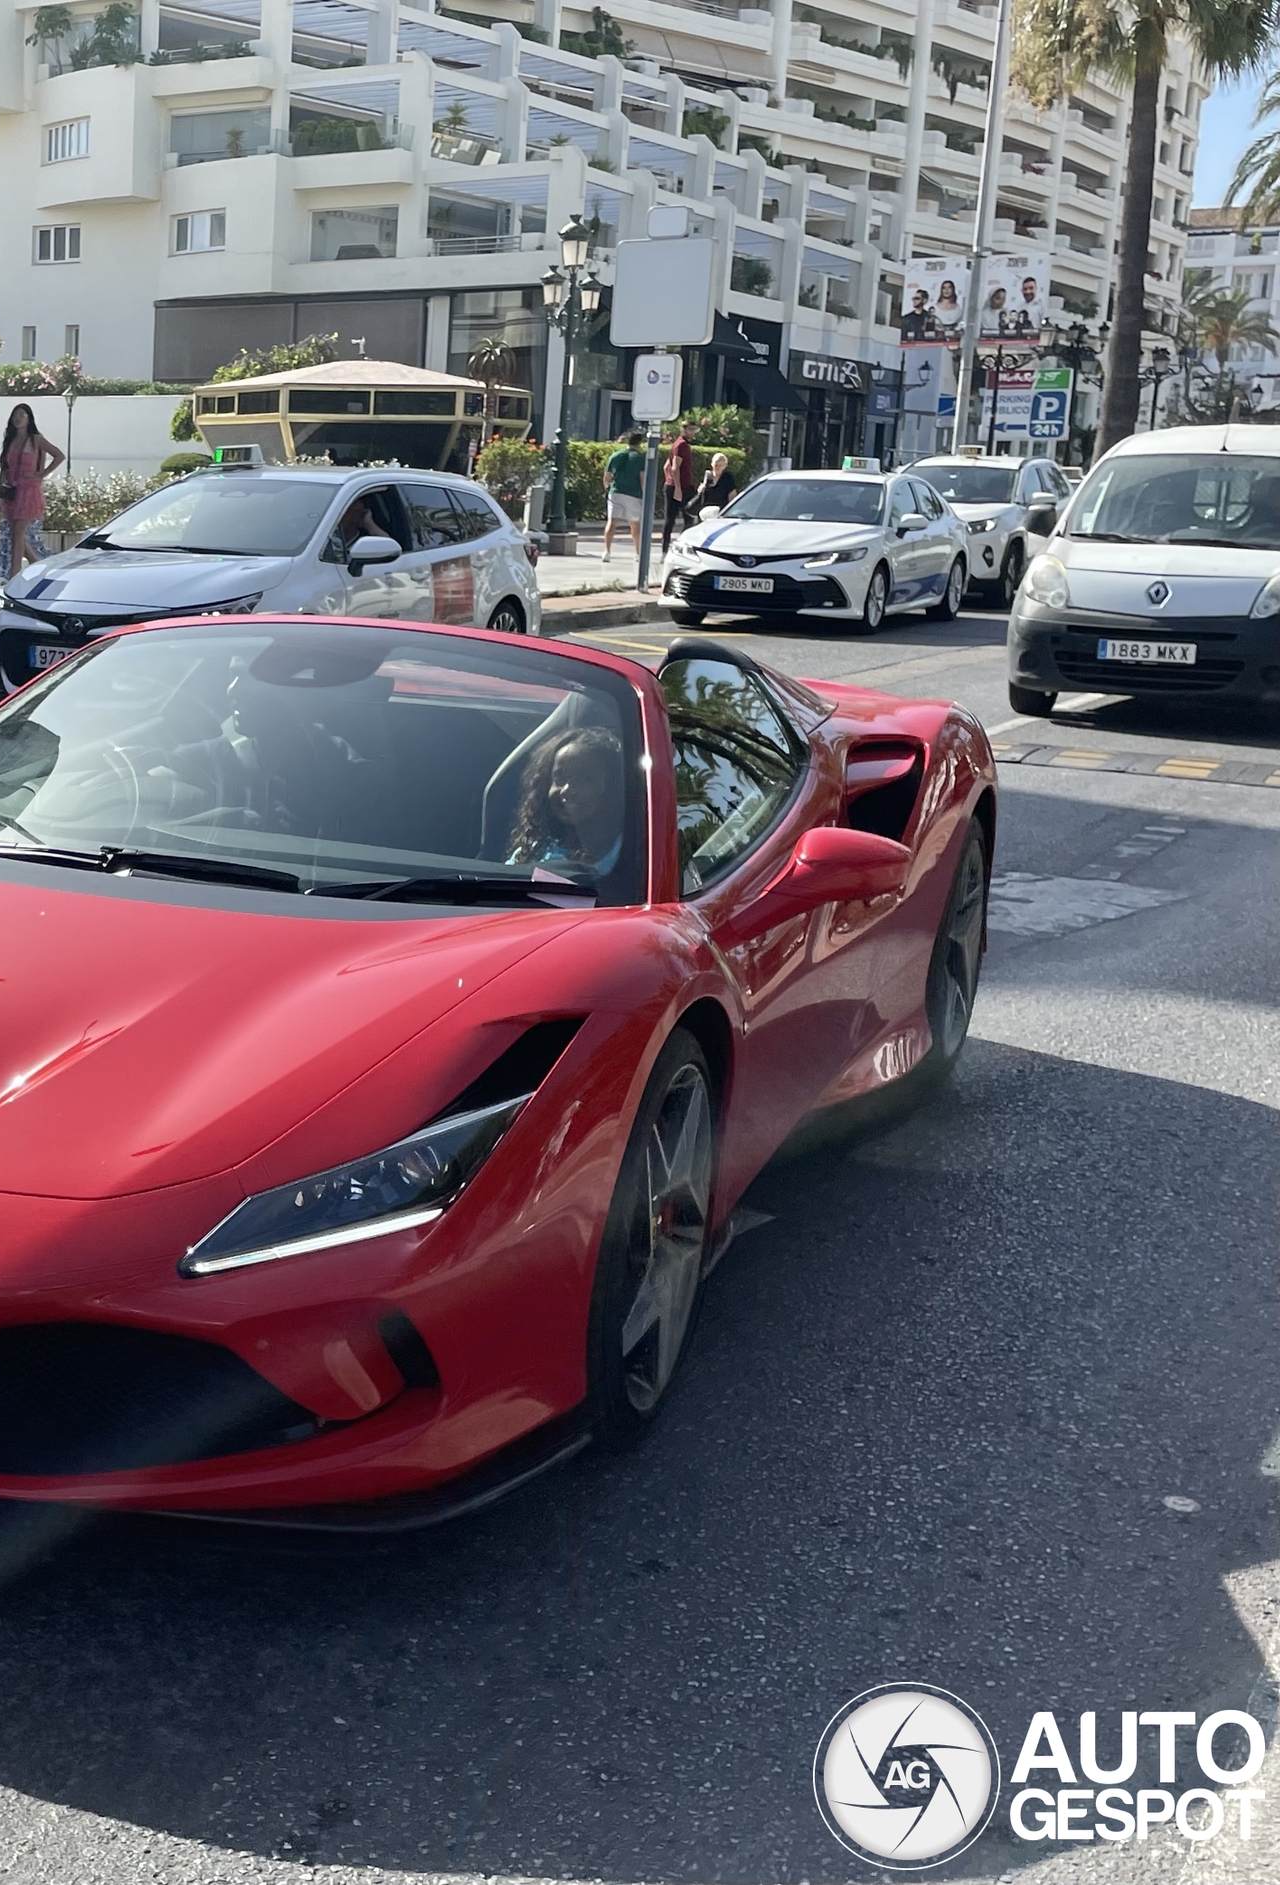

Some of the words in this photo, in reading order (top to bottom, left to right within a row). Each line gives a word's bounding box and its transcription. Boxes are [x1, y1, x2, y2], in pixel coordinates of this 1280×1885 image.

[985, 395, 1031, 403] PRKING
[984, 406, 1030, 414] PBLICO
[1039, 396, 1060, 420] P
[1033, 424, 1059, 436] 24h
[721, 578, 748, 589] 2905
[750, 580, 771, 591] MKD
[1111, 642, 1151, 659] 1883
[1156, 645, 1190, 661] MKX
